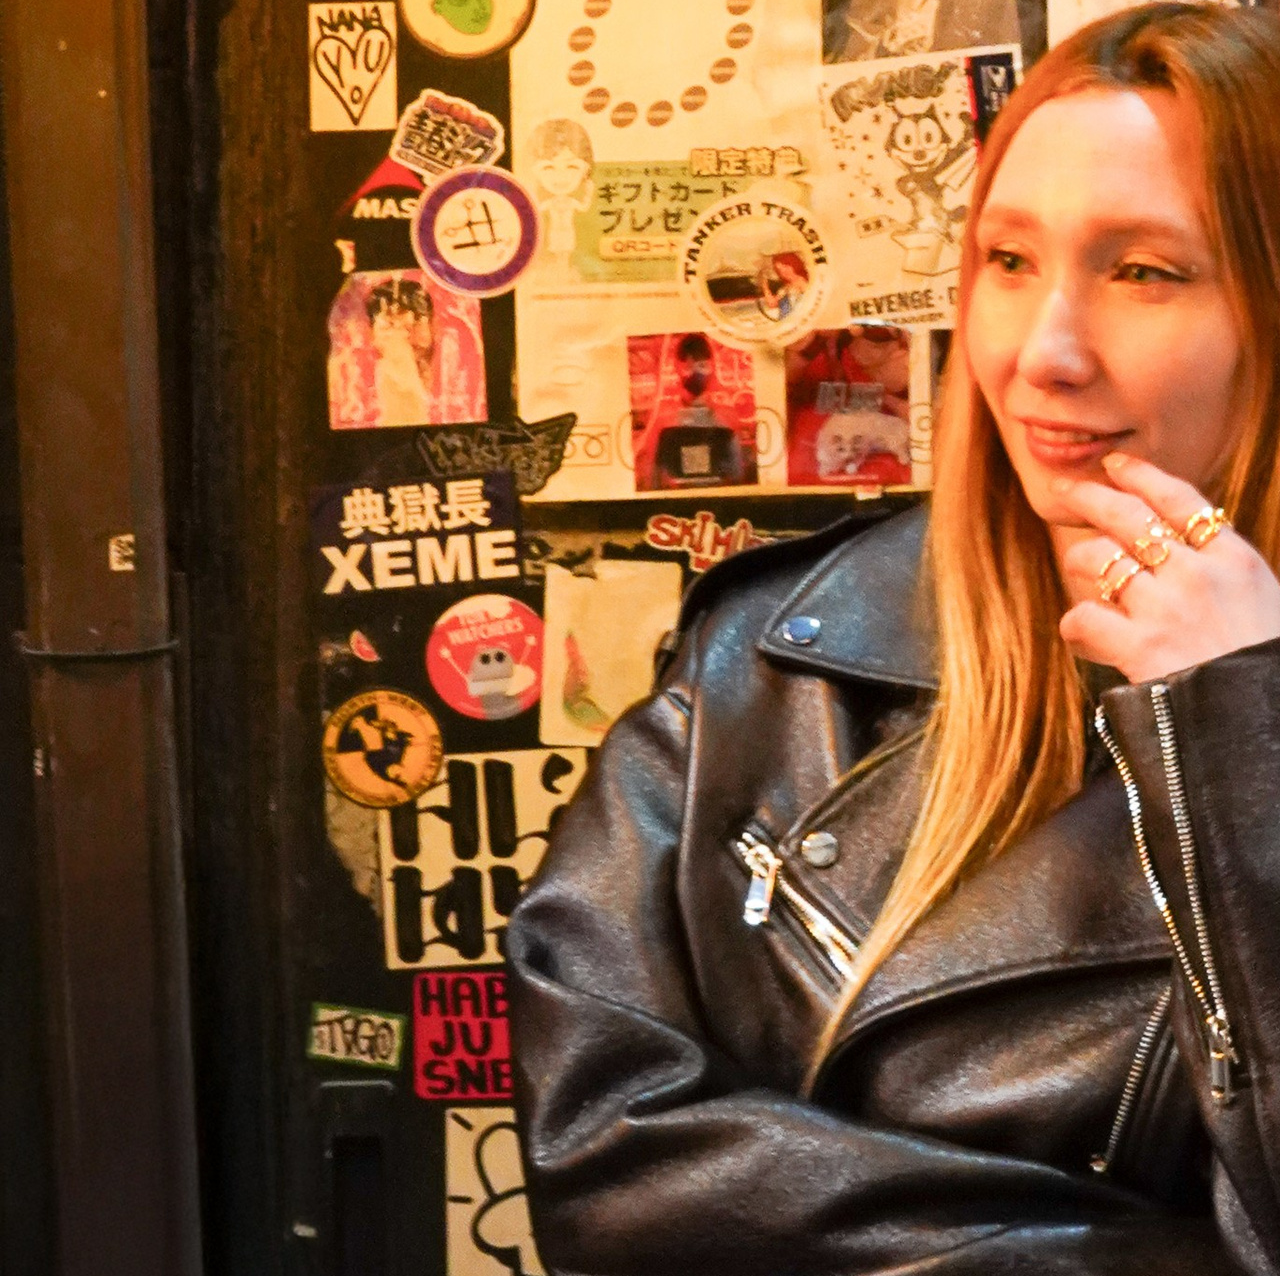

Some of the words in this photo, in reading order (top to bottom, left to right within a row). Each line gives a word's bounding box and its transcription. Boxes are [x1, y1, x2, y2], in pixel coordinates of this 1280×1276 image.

[684, 201, 752, 285] TANKER
[761, 201, 828, 265] TRASH
[321, 528, 519, 594] XEME
